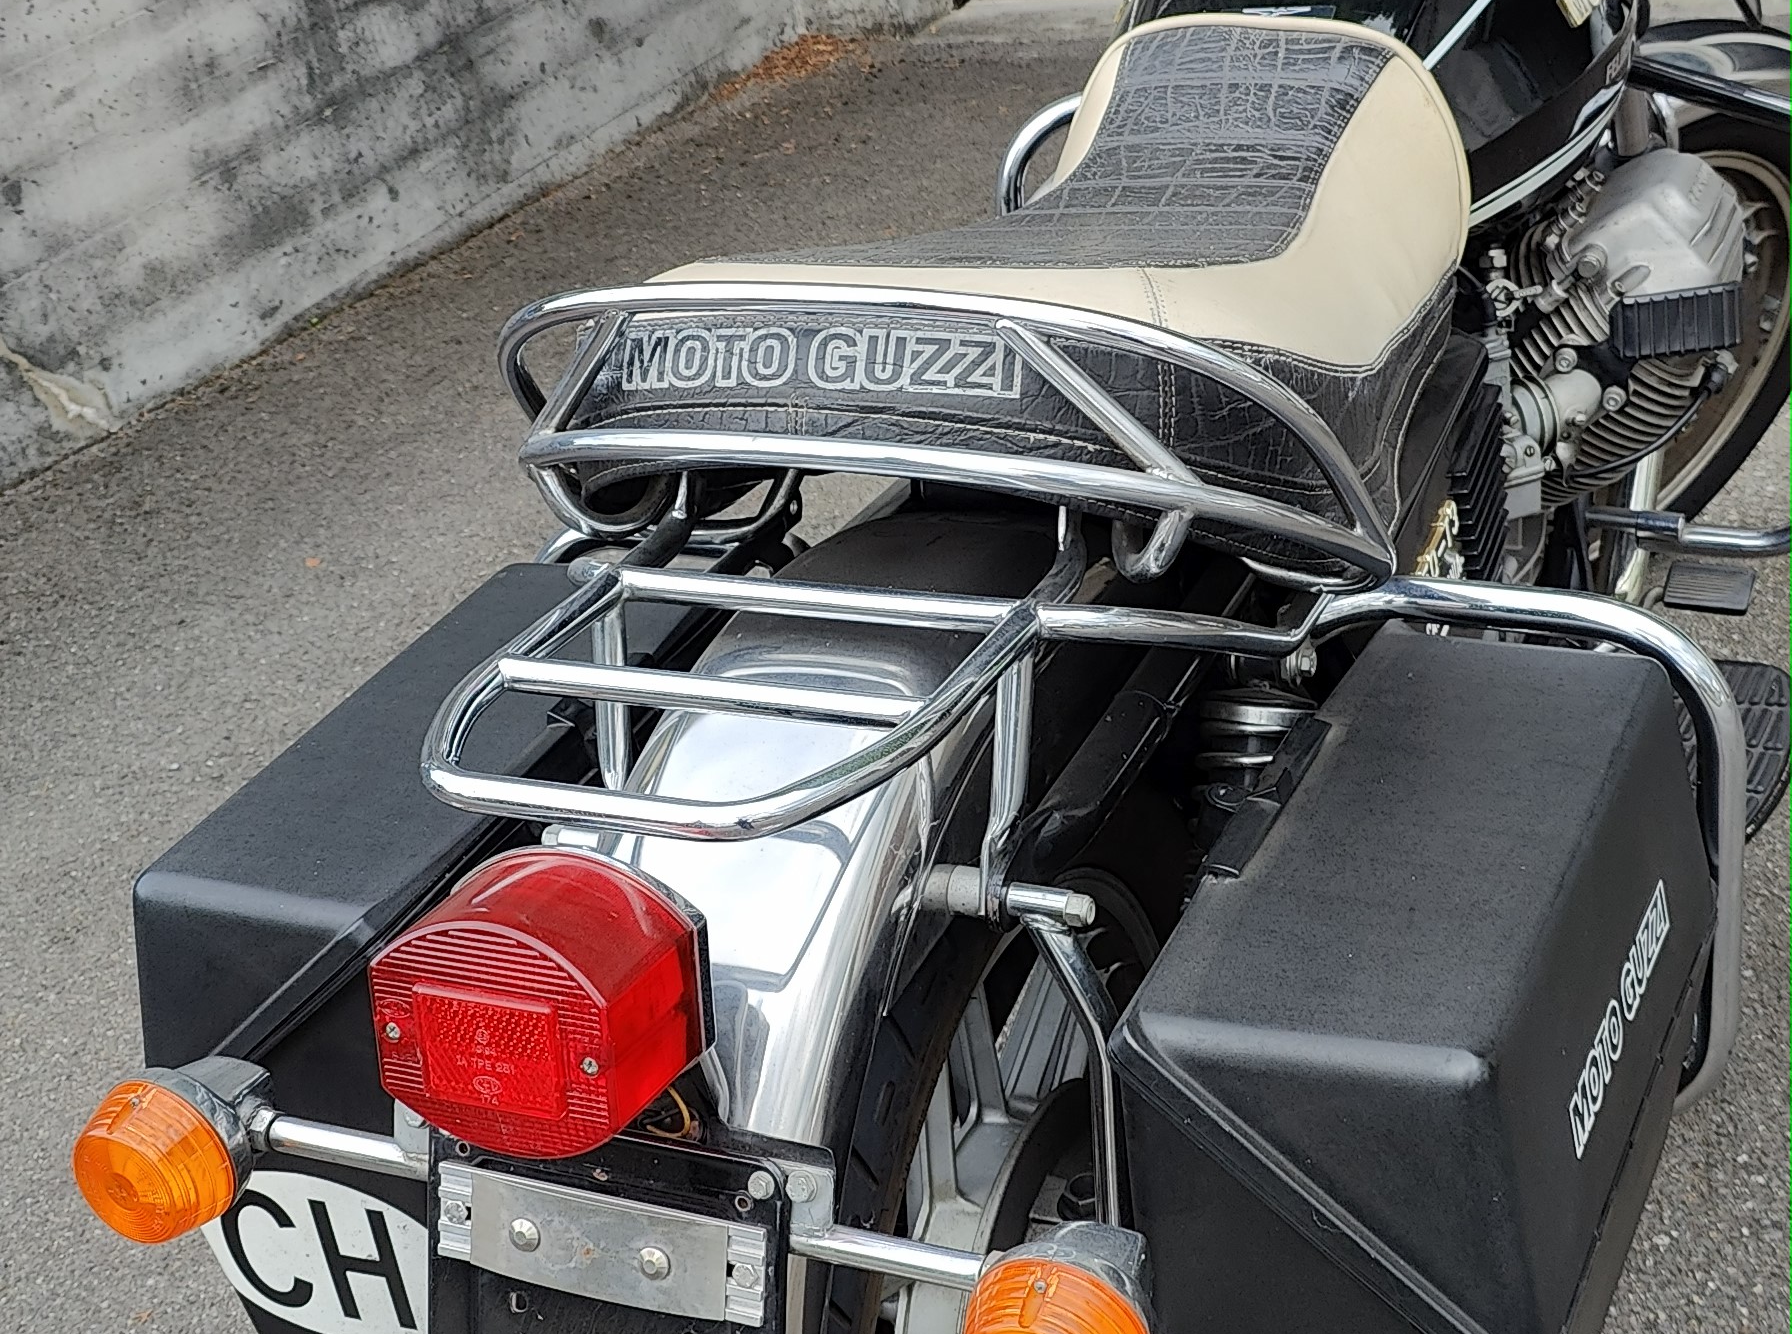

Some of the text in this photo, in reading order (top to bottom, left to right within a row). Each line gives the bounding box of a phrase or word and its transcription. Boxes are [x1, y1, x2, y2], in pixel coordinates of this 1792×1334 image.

[622, 327, 1021, 398] MOTO GUZZI
[1569, 879, 1670, 1160] MOTO GUZZI
[221, 1189, 417, 1330] CH
